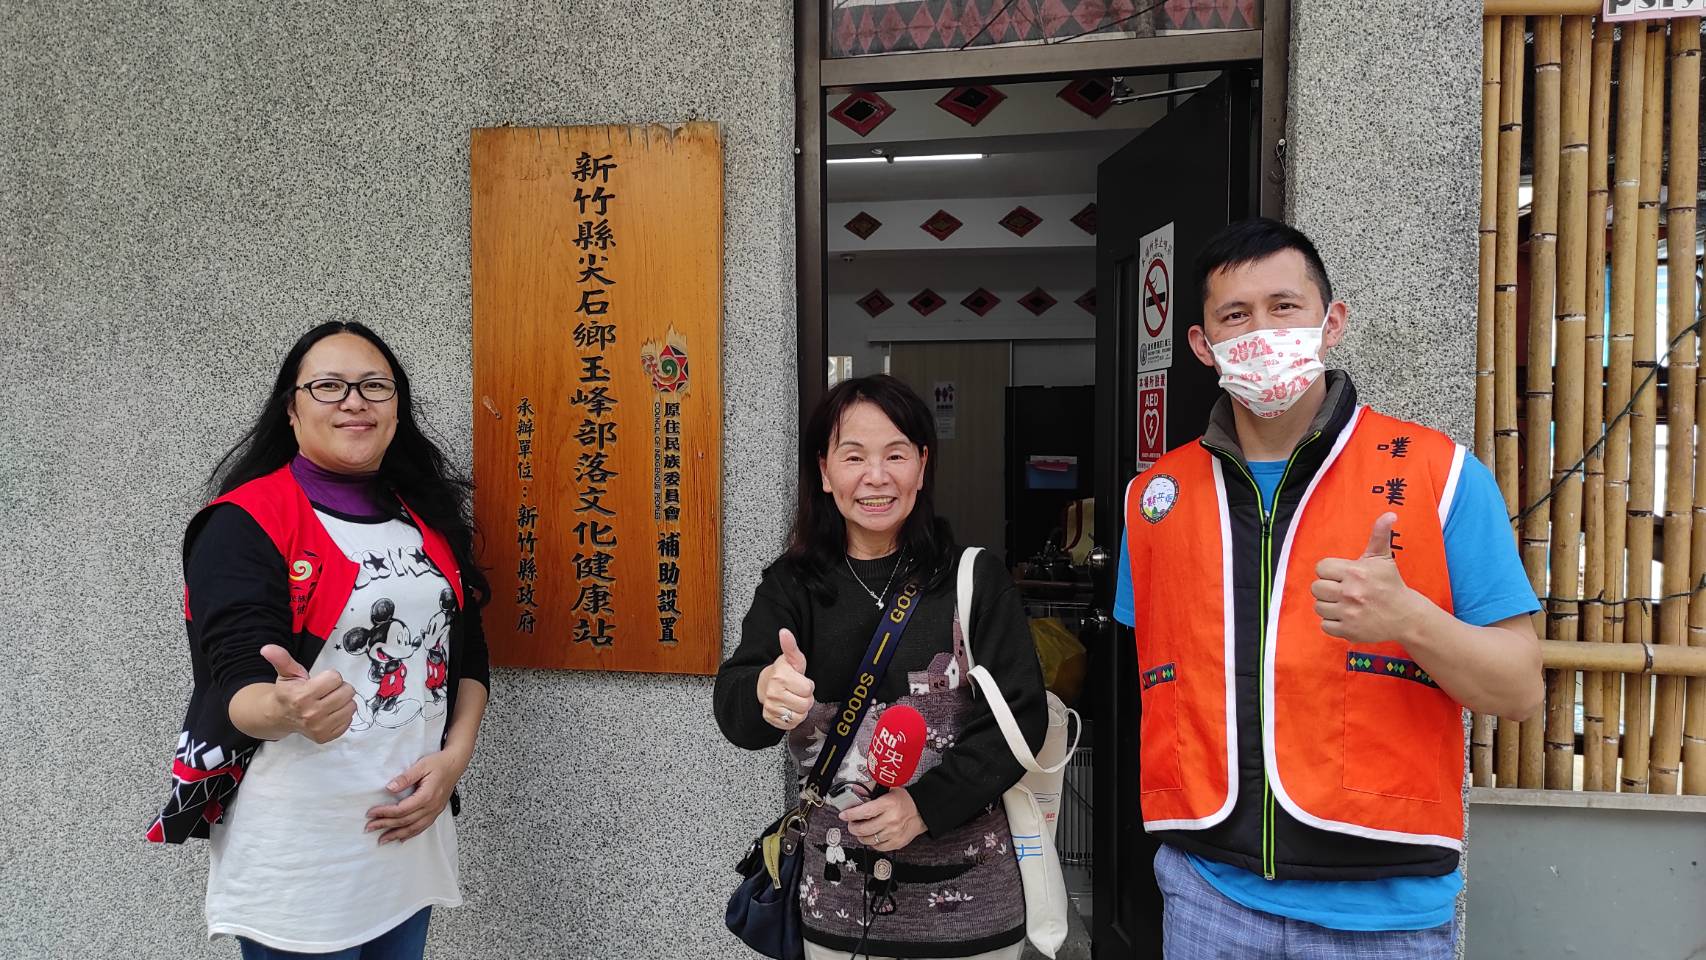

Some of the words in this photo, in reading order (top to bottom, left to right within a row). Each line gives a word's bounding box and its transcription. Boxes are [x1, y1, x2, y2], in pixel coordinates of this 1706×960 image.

[570, 152, 618, 647] 新竹縣尖石鄉玉峰部落文化健康站
[1144, 393, 1159, 407] AED
[654, 436, 661, 446] OF
[664, 402, 681, 521] 原住民族委員會
[657, 532, 681, 643] 補助設置
[836, 672, 875, 738] GOODS
[872, 735, 904, 769] 中央
